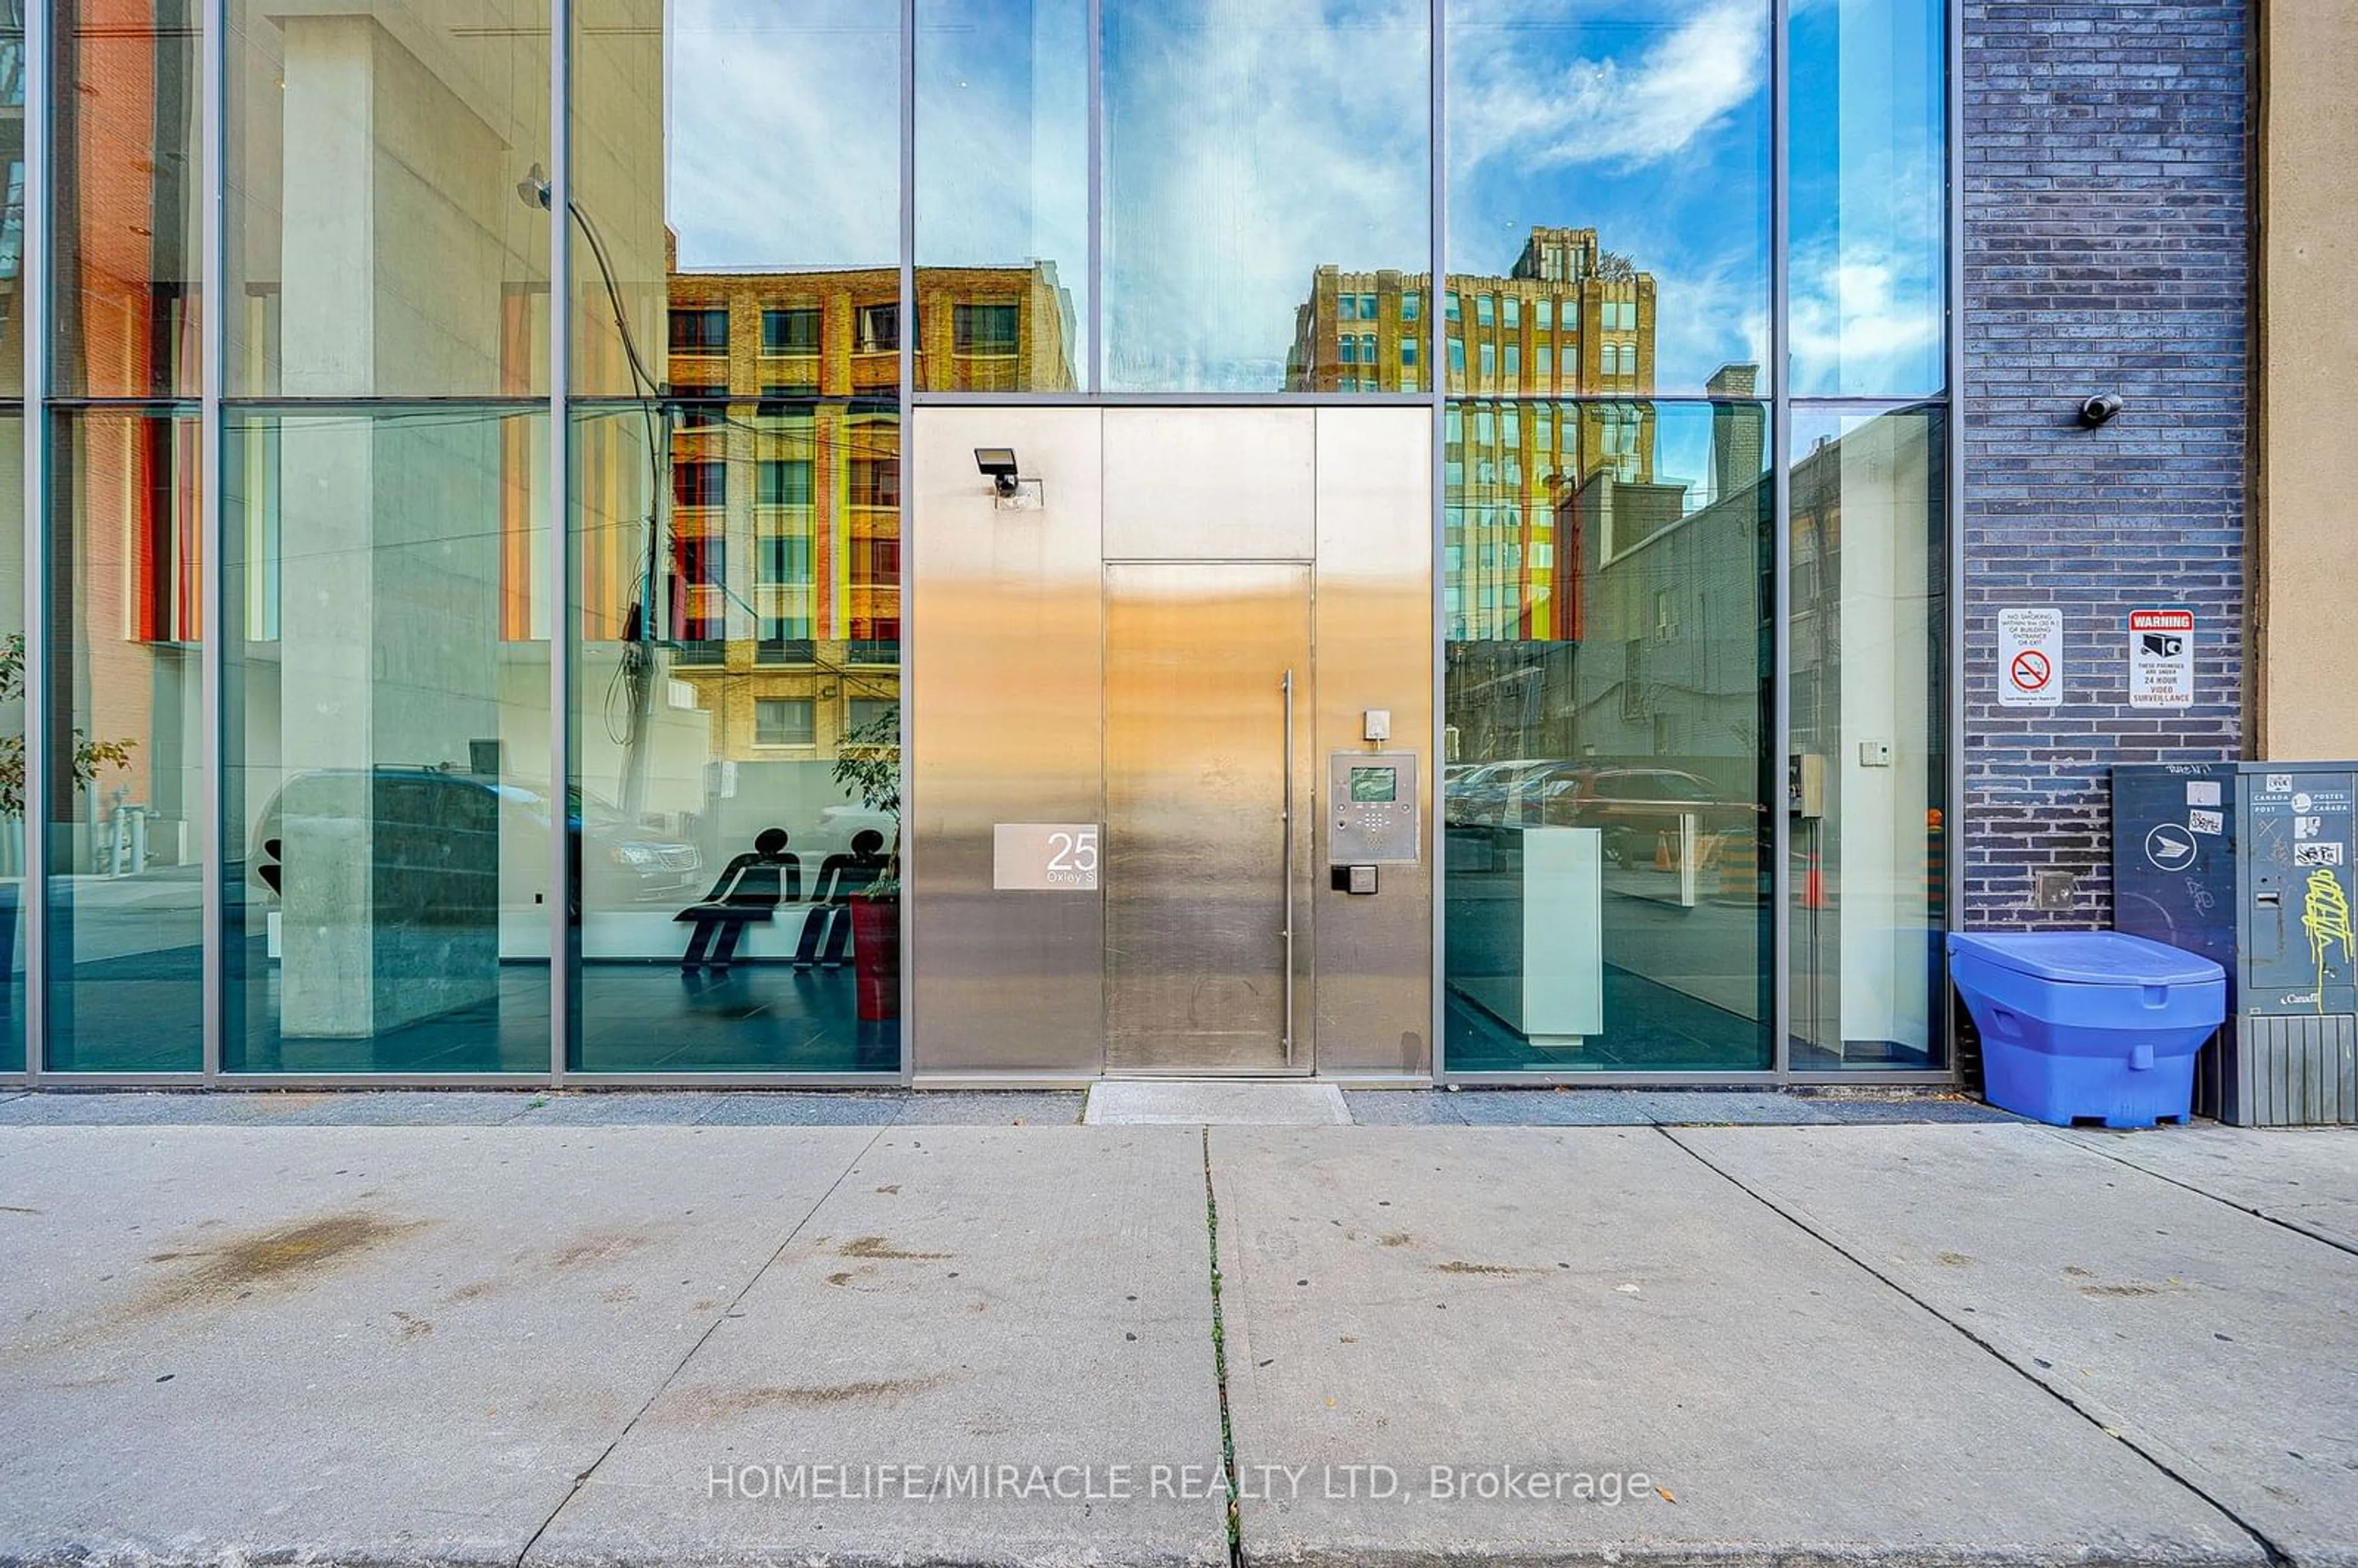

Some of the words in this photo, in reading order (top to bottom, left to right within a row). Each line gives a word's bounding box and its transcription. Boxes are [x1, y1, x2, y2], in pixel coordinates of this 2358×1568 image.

[2134, 616, 2190, 627] WARNING
[1048, 833, 1097, 871] 25
[1048, 871, 1081, 884] Oxley
